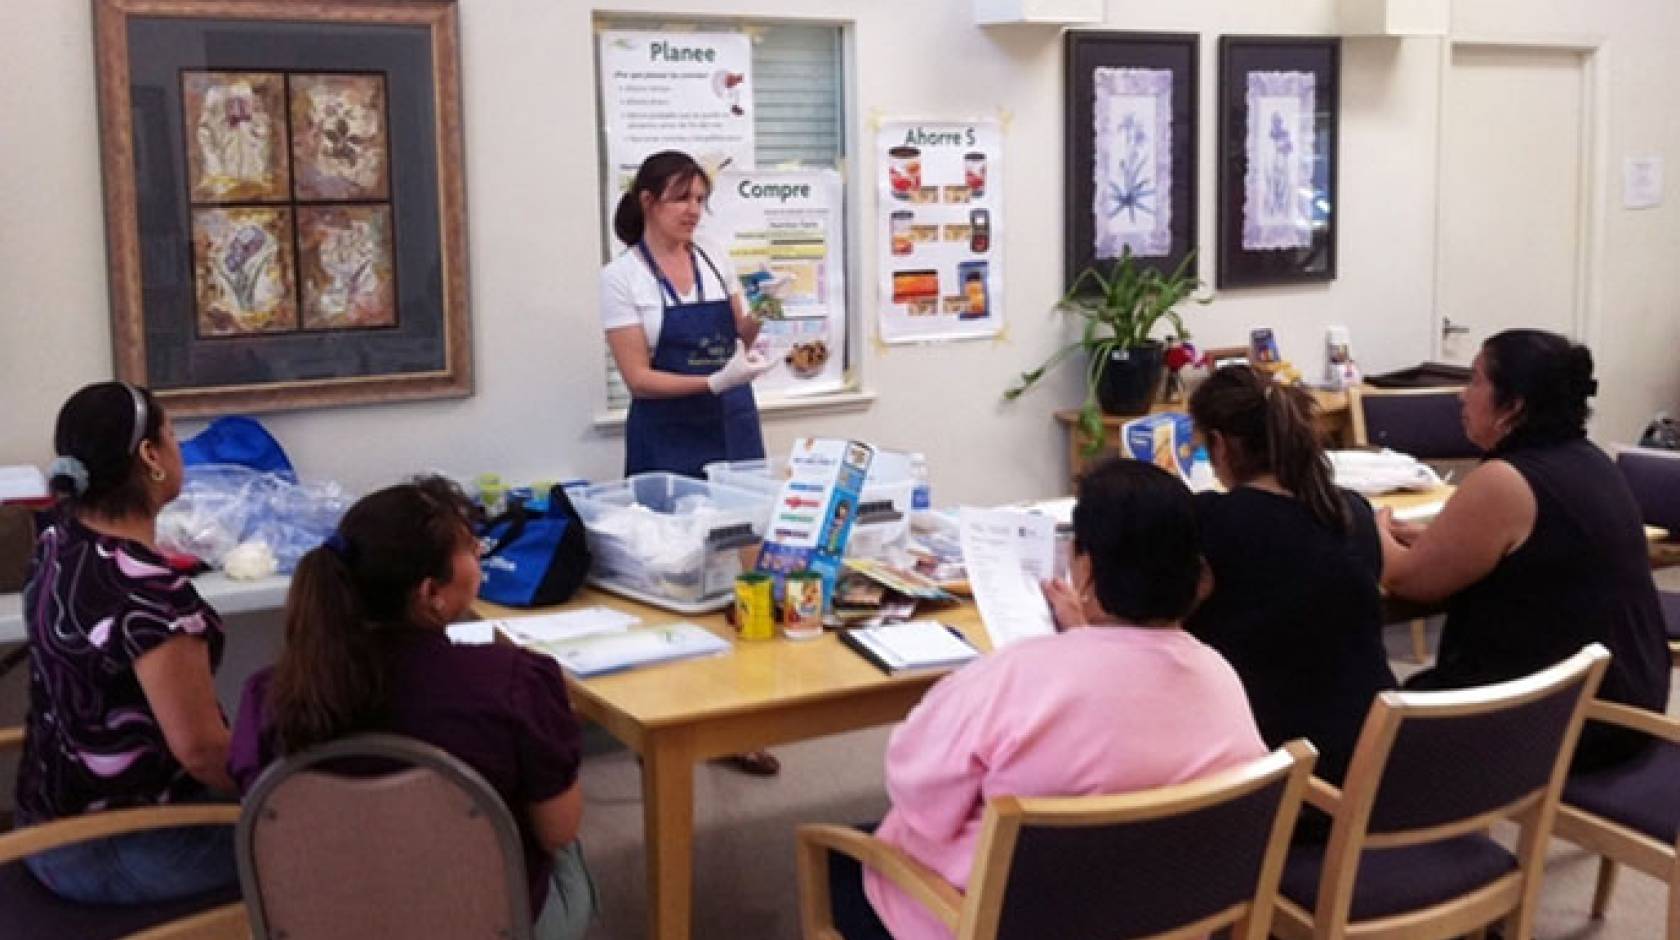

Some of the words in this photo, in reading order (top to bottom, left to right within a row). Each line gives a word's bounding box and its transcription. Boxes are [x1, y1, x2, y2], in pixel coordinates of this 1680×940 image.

[650, 40, 715, 61] Planee
[905, 127, 960, 146] Ahorre
[738, 180, 810, 203] Compre
